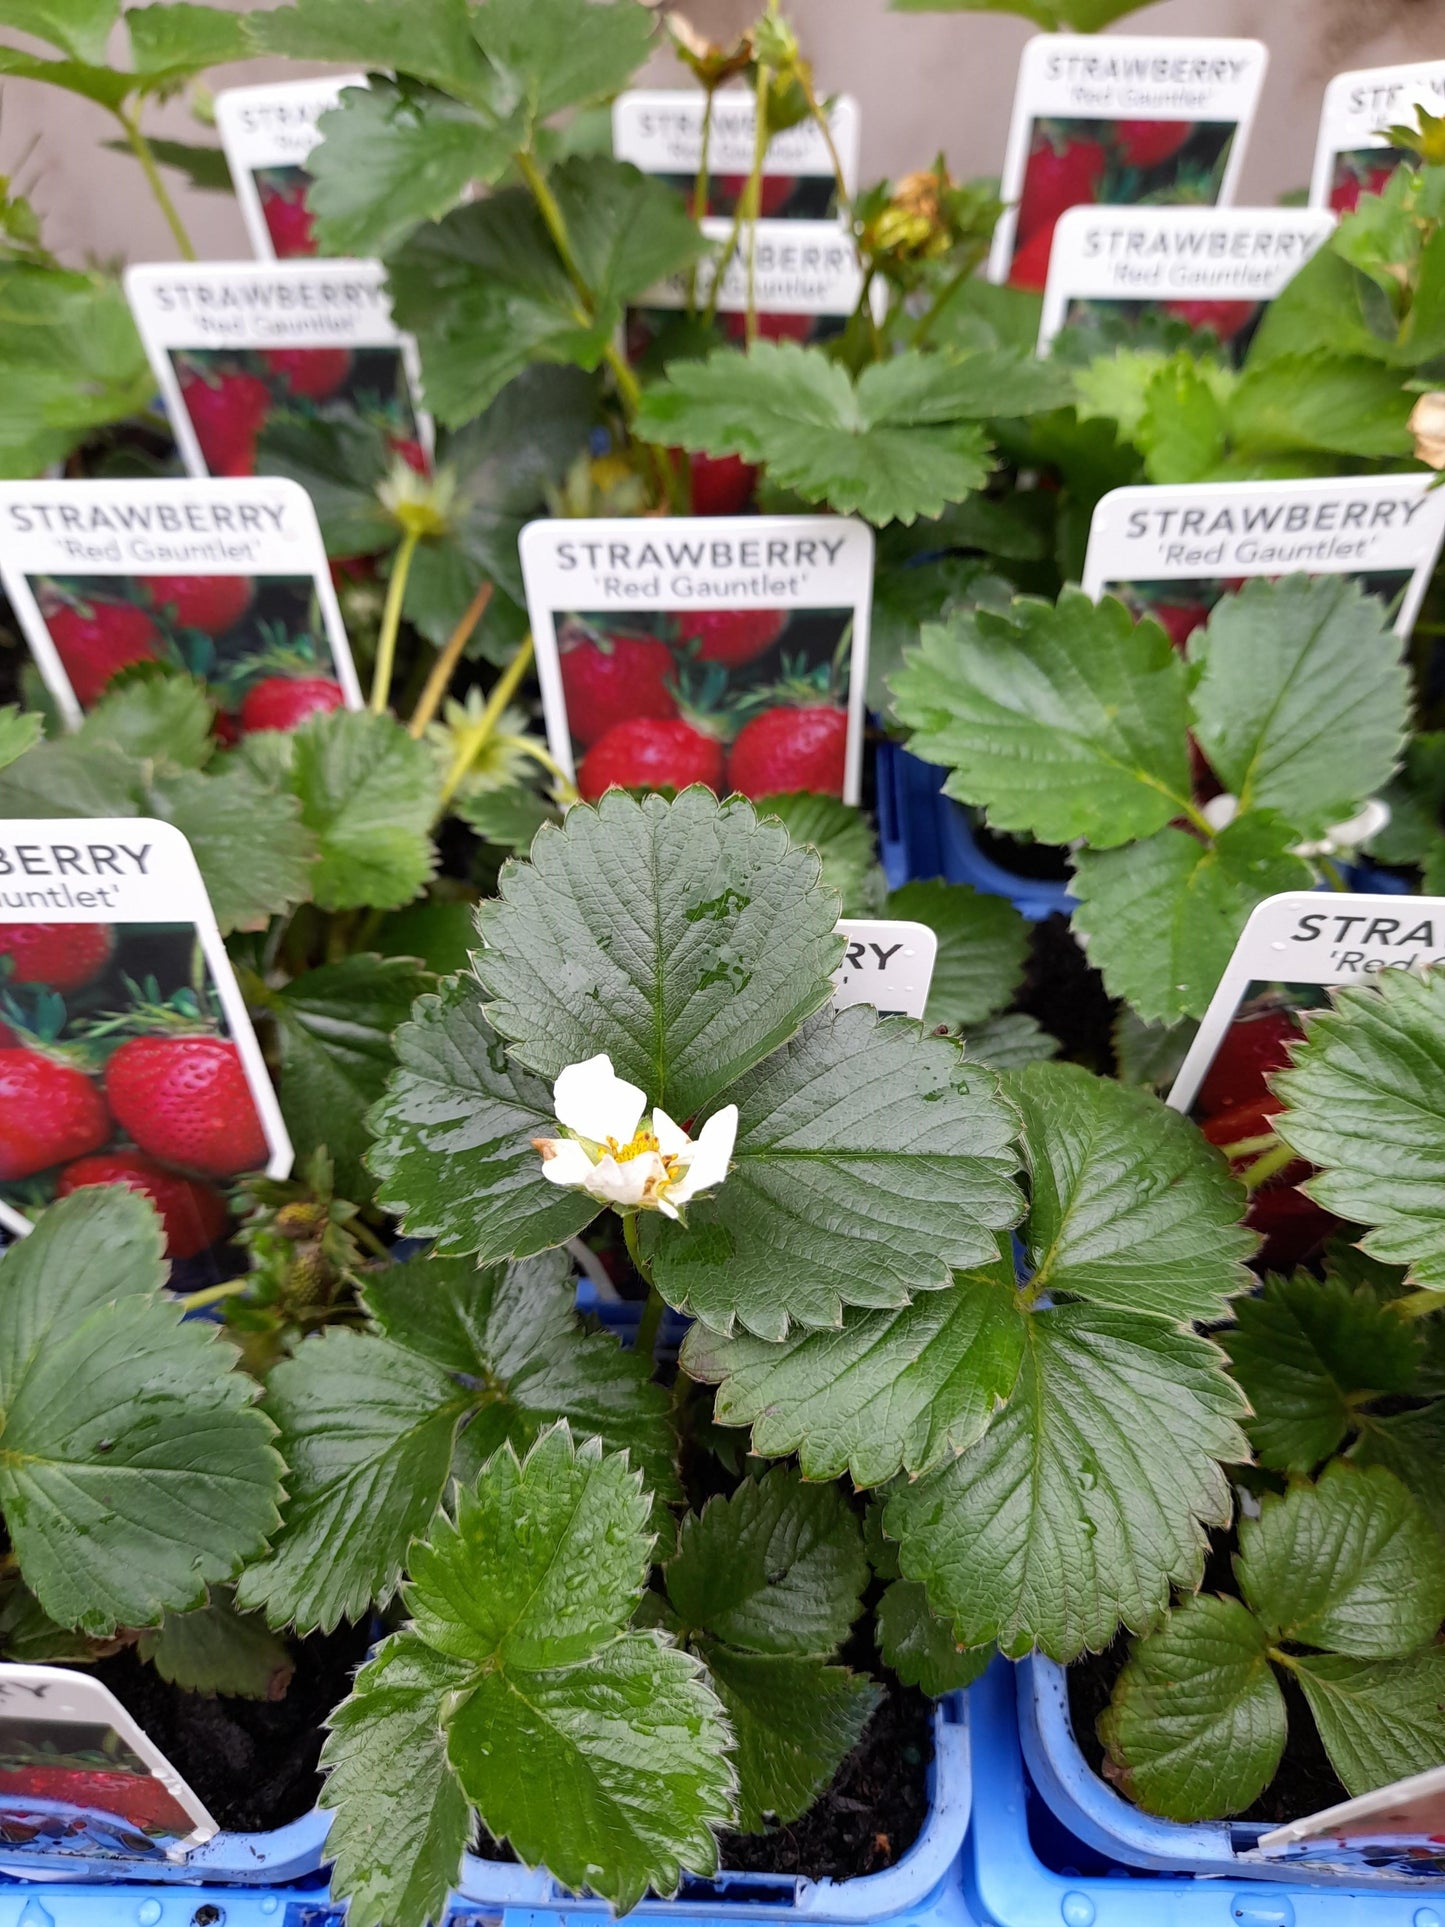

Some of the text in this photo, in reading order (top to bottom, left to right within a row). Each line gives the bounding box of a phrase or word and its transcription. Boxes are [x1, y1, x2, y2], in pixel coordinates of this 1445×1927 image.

[1084, 229, 1319, 258] STRAWBERRY
[9, 503, 287, 533] STRAWBERRY
[1126, 498, 1427, 539] STRAWBERRY
[57, 538, 263, 563] 'Red Gauntlet'
[555, 537, 846, 571] STRAWBERRY
[1157, 536, 1376, 567] 'Red Gauntlet'
[594, 573, 808, 599] 'Red Gauntlet'
[0, 883, 119, 908] untlet'
